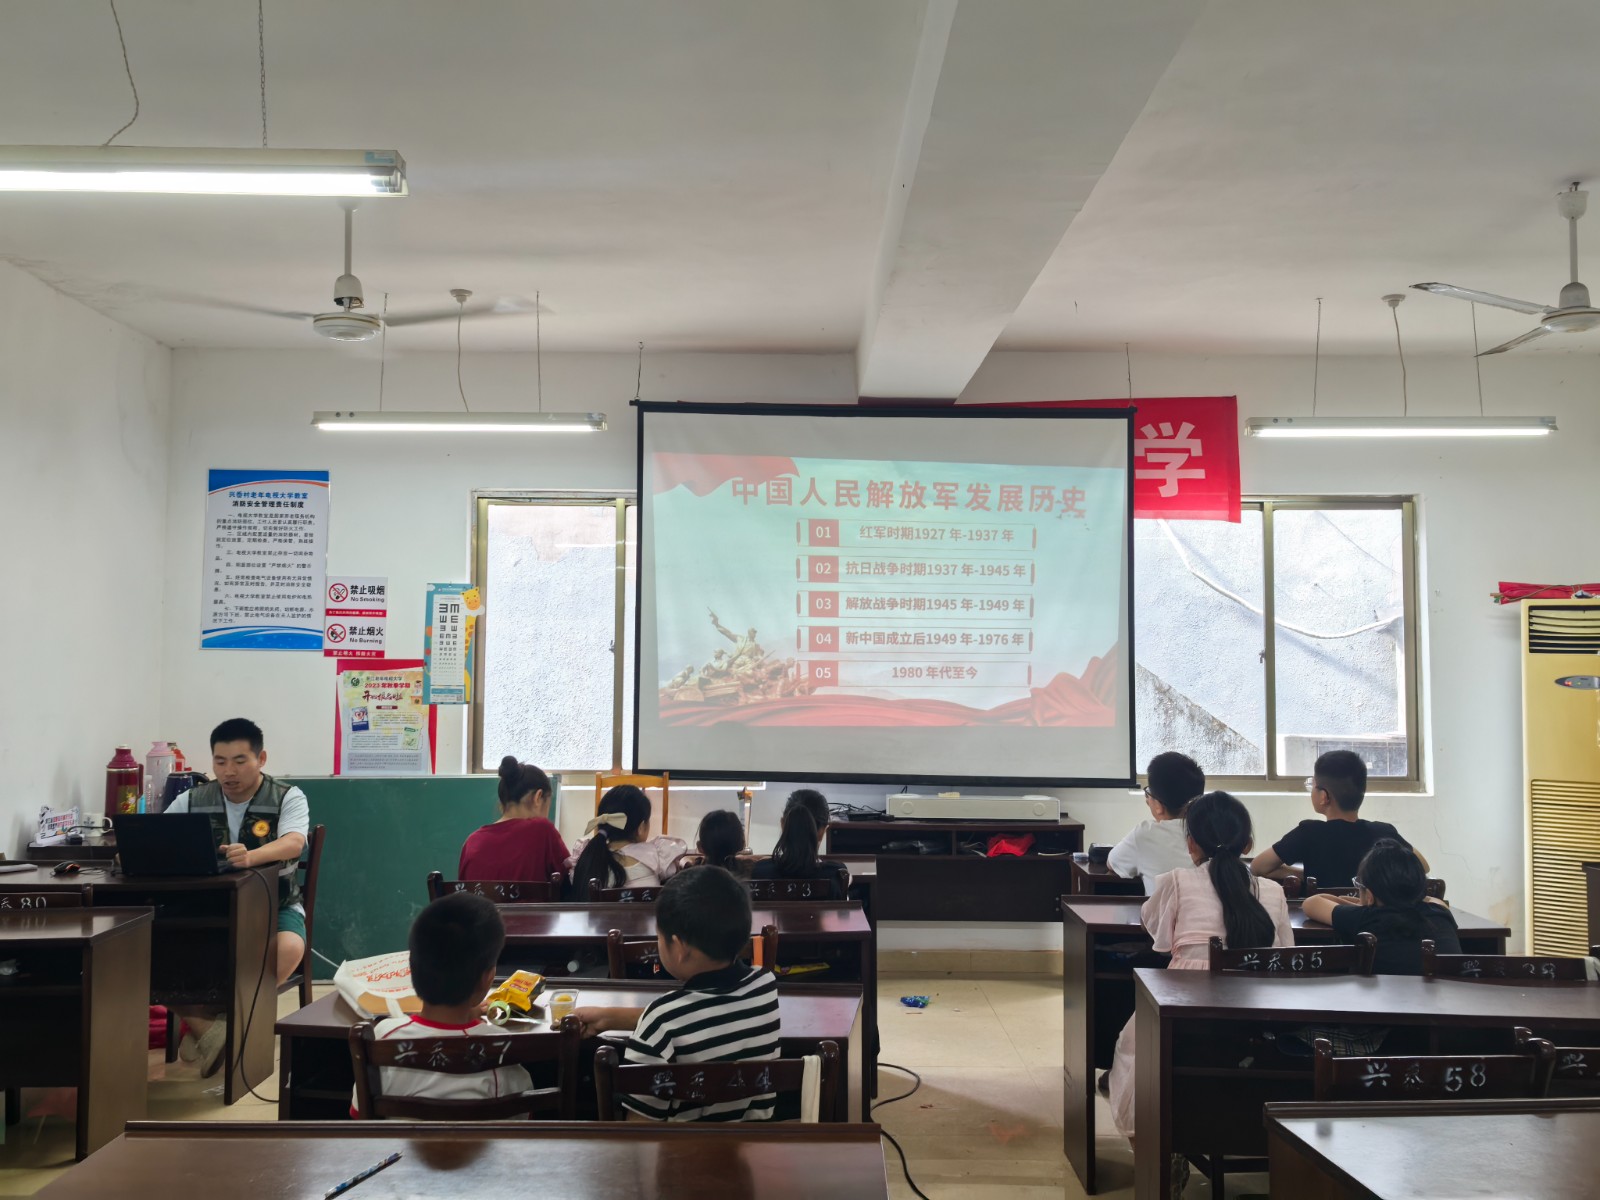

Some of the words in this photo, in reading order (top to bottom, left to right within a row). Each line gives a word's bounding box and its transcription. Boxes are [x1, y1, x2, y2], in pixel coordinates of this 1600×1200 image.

[1134, 420, 1206, 498] 学
[731, 476, 1086, 514] 中国人民解放军发展历史
[232, 501, 305, 509] 消防安全管理责任制度
[815, 526, 832, 539] 01
[815, 563, 832, 575] 02
[350, 585, 385, 595] 禁止吸烟
[815, 598, 832, 610] 03
[349, 626, 384, 636] 禁止烟火
[815, 633, 832, 645] 04
[815, 667, 832, 679] 05
